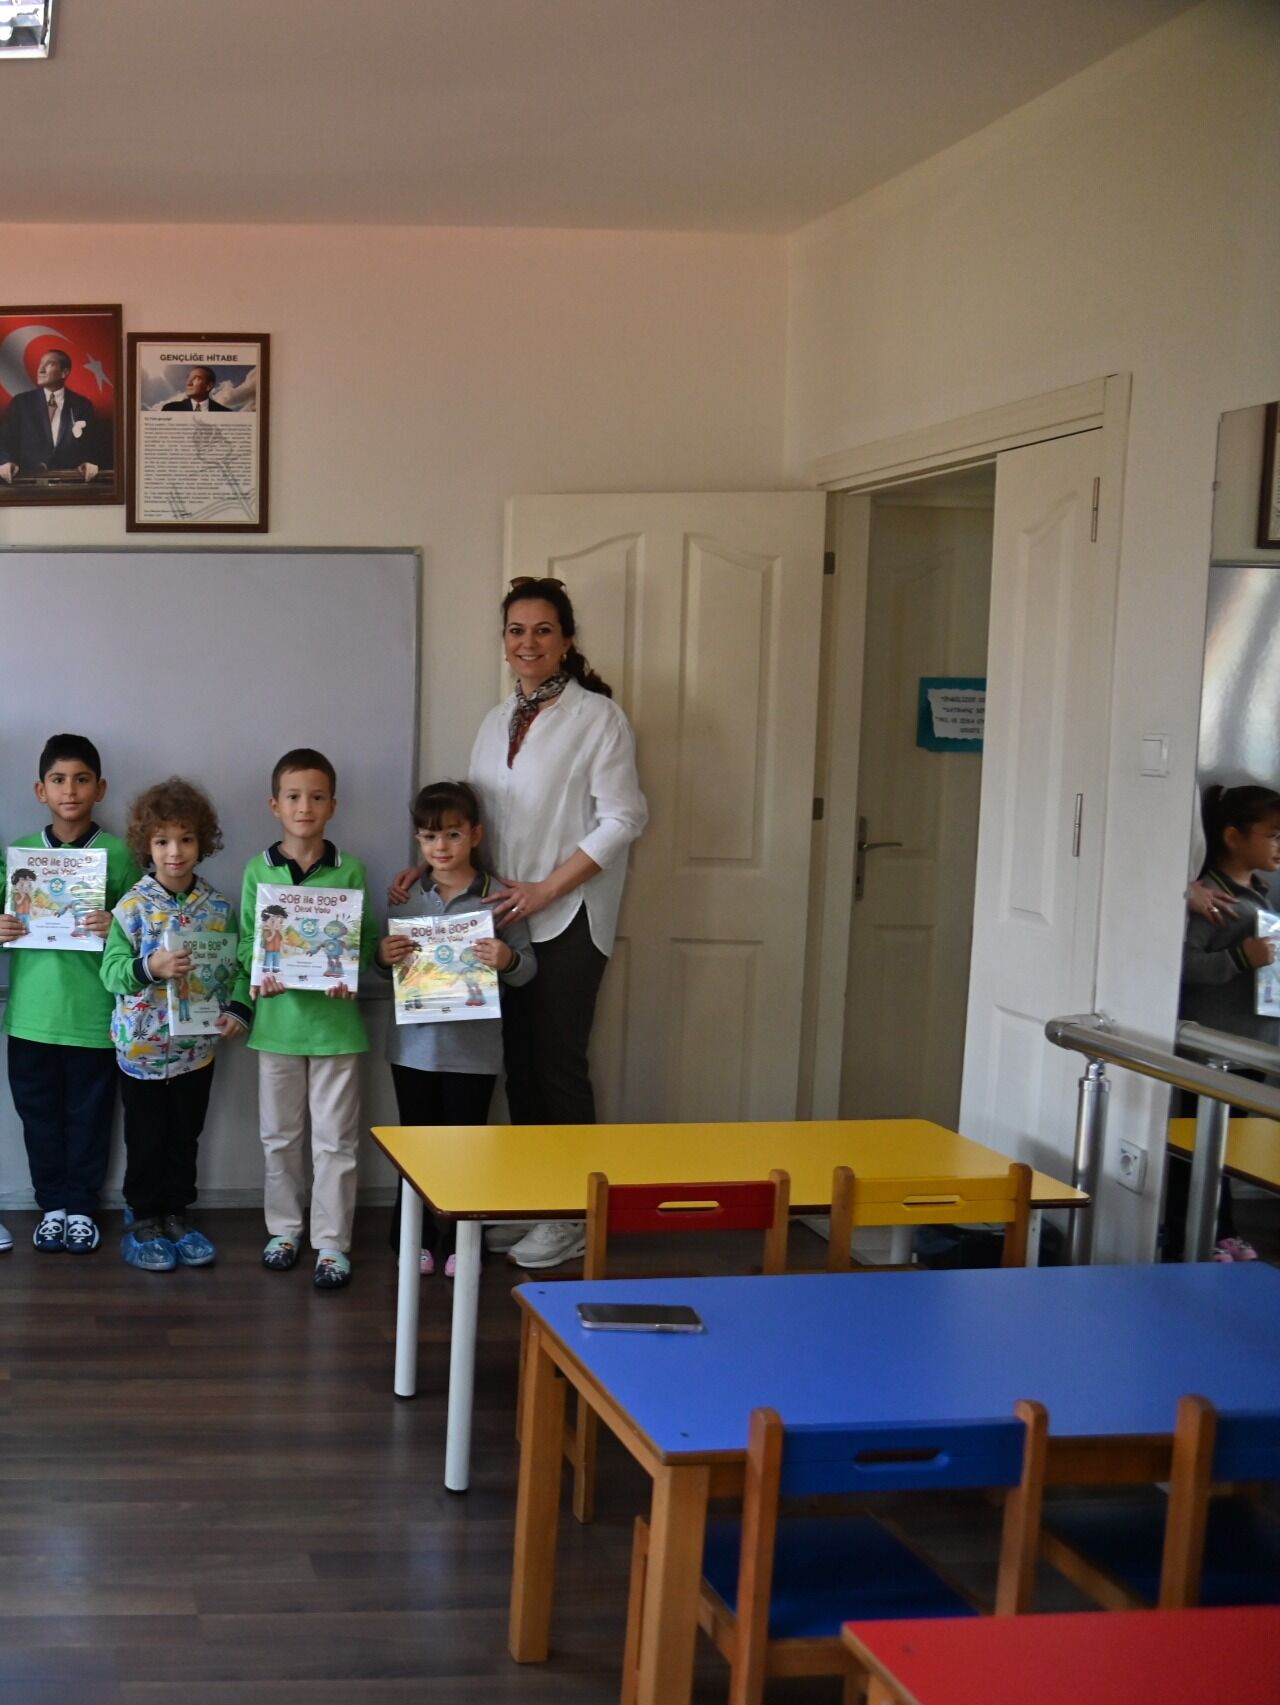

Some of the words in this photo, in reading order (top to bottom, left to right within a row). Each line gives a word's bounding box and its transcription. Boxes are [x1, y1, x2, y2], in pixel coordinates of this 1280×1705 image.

[160, 353, 204, 362] GENÇLİĞE
[207, 353, 238, 361] HİTABE
[27, 857, 48, 866] ROB
[279, 893, 301, 904] ROB
[303, 896, 314, 904] ile
[317, 896, 338, 906] BOB
[411, 927, 432, 937] ROB
